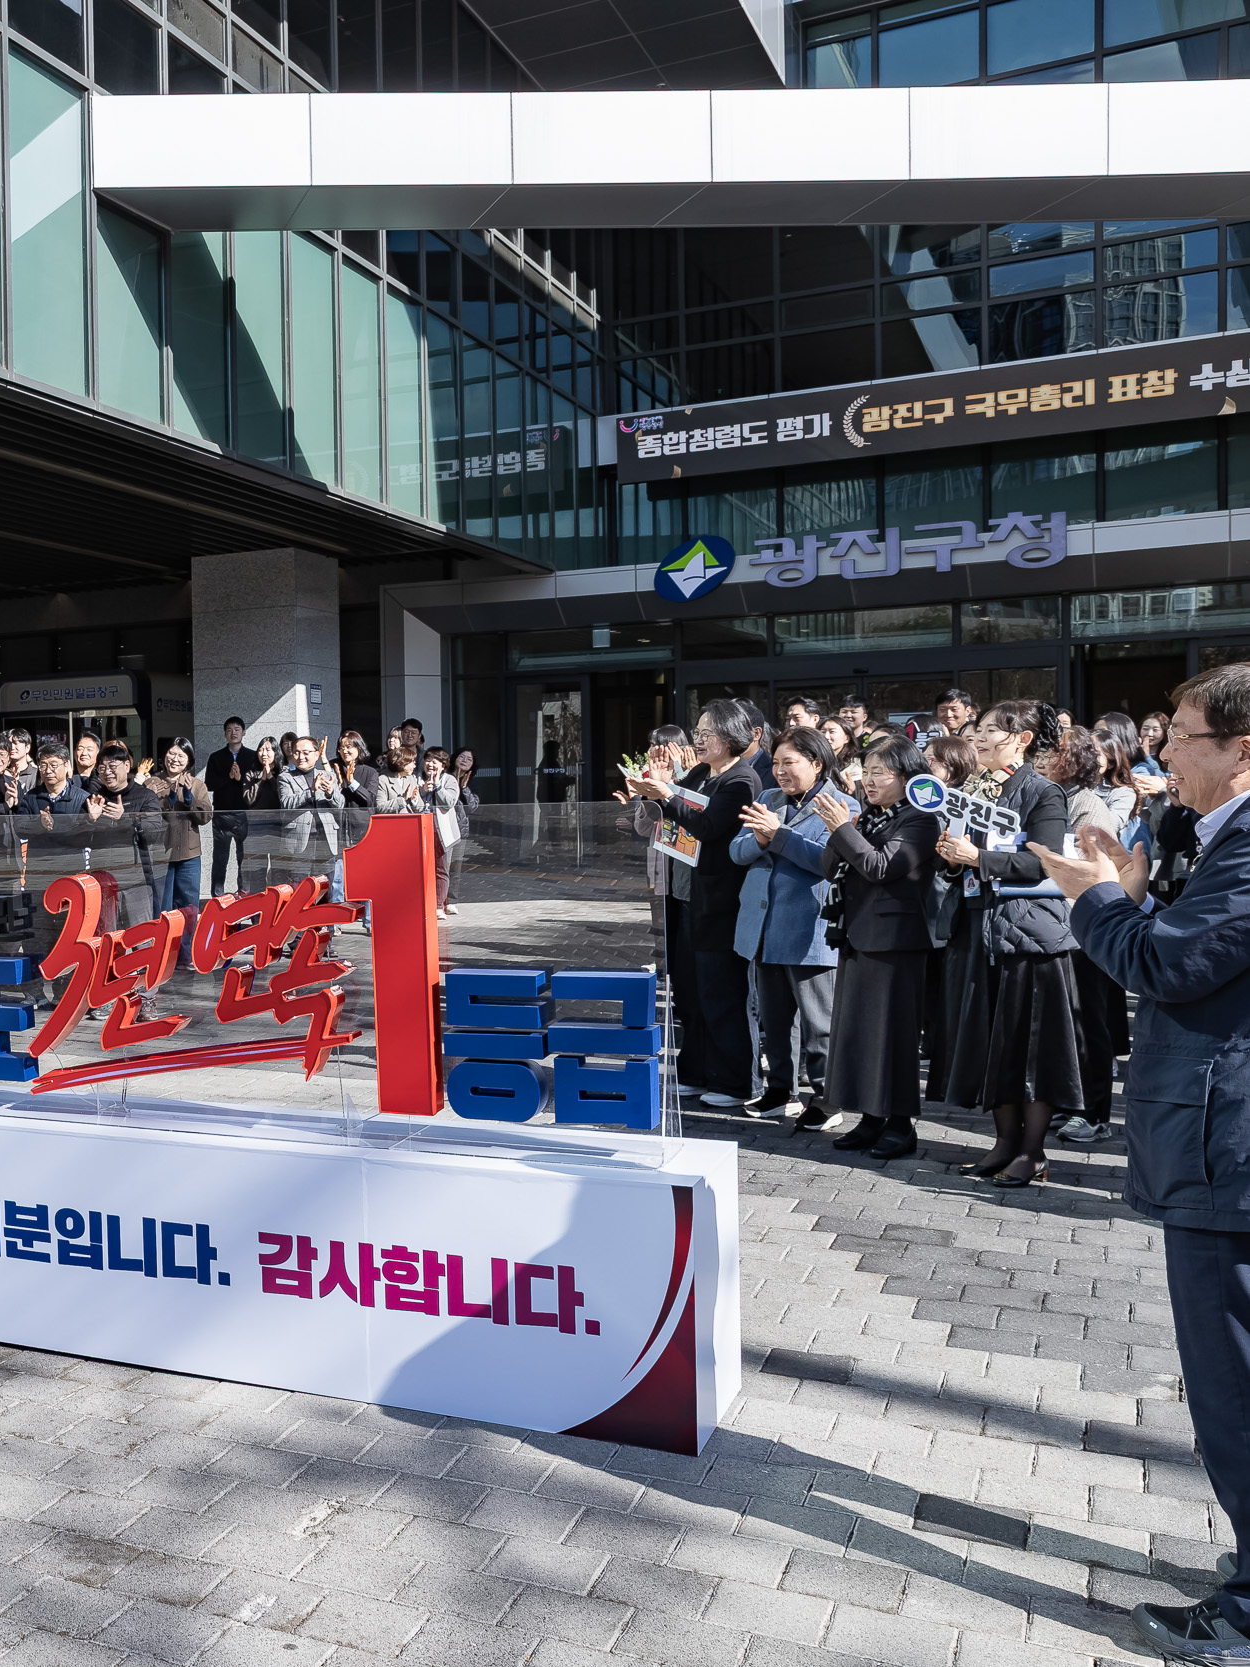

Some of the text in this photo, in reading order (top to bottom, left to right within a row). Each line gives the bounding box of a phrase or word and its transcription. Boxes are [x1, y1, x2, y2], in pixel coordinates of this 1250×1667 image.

[637, 420, 768, 459] 종합청렴도
[777, 412, 832, 442] 평가
[861, 397, 954, 434] 광진구
[964, 379, 1096, 420] 국무총리
[1107, 368, 1178, 402] 표창
[749, 511, 1067, 588] 광진구청
[31, 685, 119, 702] 무인민원발급창구
[945, 791, 1016, 837] 광진구
[28, 873, 193, 1059] 3년
[191, 874, 365, 1082] 연속
[258, 1231, 600, 1336] 감사합니다.
